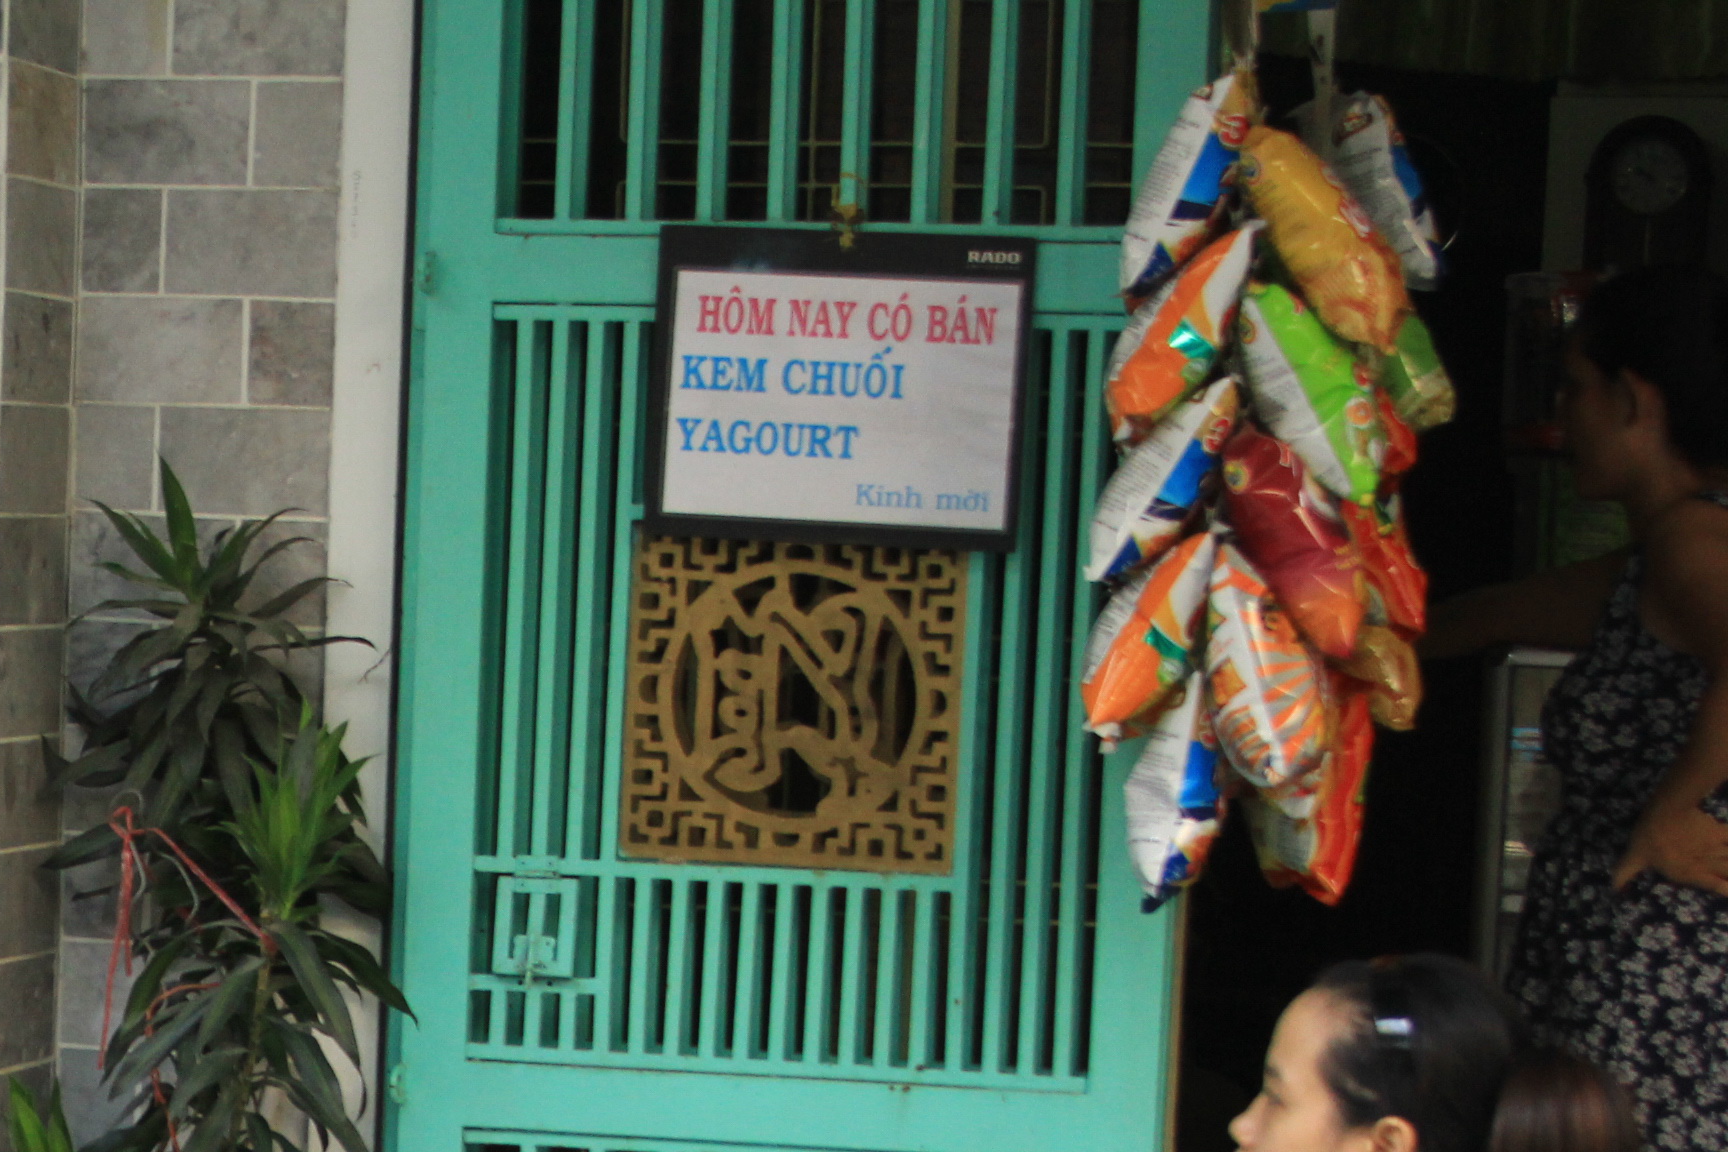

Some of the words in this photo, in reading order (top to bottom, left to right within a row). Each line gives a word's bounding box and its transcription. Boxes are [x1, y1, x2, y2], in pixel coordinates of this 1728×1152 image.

[967, 250, 1022, 264] RADO
[696, 286, 776, 336] HÔM
[786, 298, 858, 339] NAY
[867, 293, 913, 342] CÓ
[925, 295, 997, 345] BÁN
[680, 354, 769, 393] KEM
[781, 346, 905, 400] CHUỐI
[676, 417, 860, 459] YAGOURT
[935, 490, 990, 513] mời
